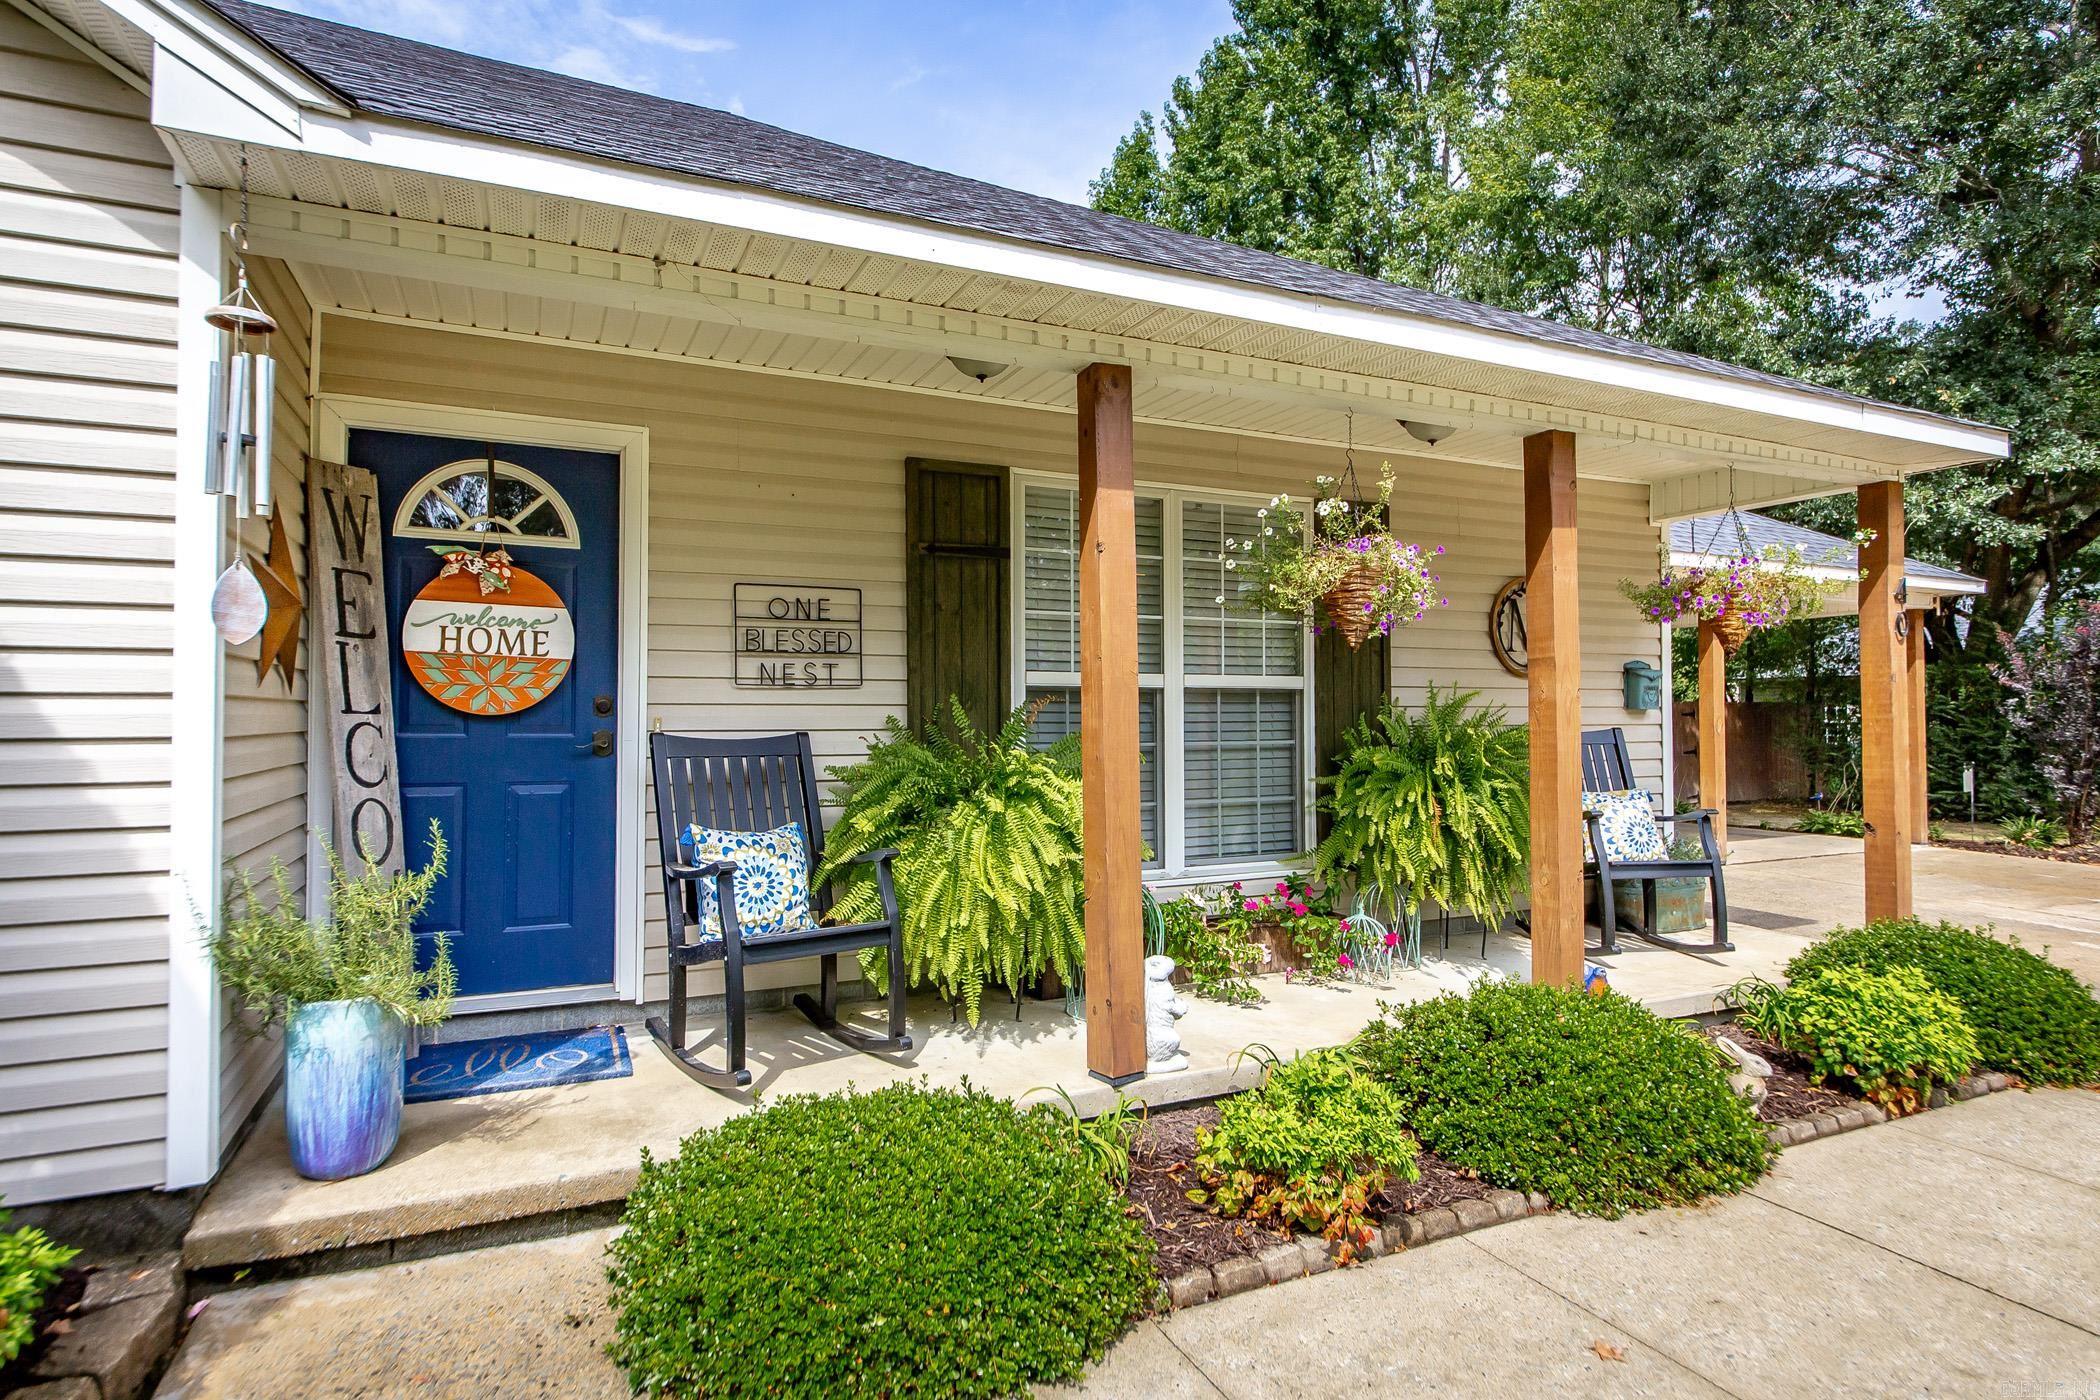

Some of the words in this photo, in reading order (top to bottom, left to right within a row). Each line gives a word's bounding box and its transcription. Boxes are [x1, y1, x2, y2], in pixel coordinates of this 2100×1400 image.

[411, 605, 559, 629] welcome
[768, 597, 831, 621] ONE
[438, 625, 550, 657] HOME
[745, 628, 853, 653] BLESSED
[760, 661, 839, 686] NEST
[406, 1043, 589, 1087] ello
